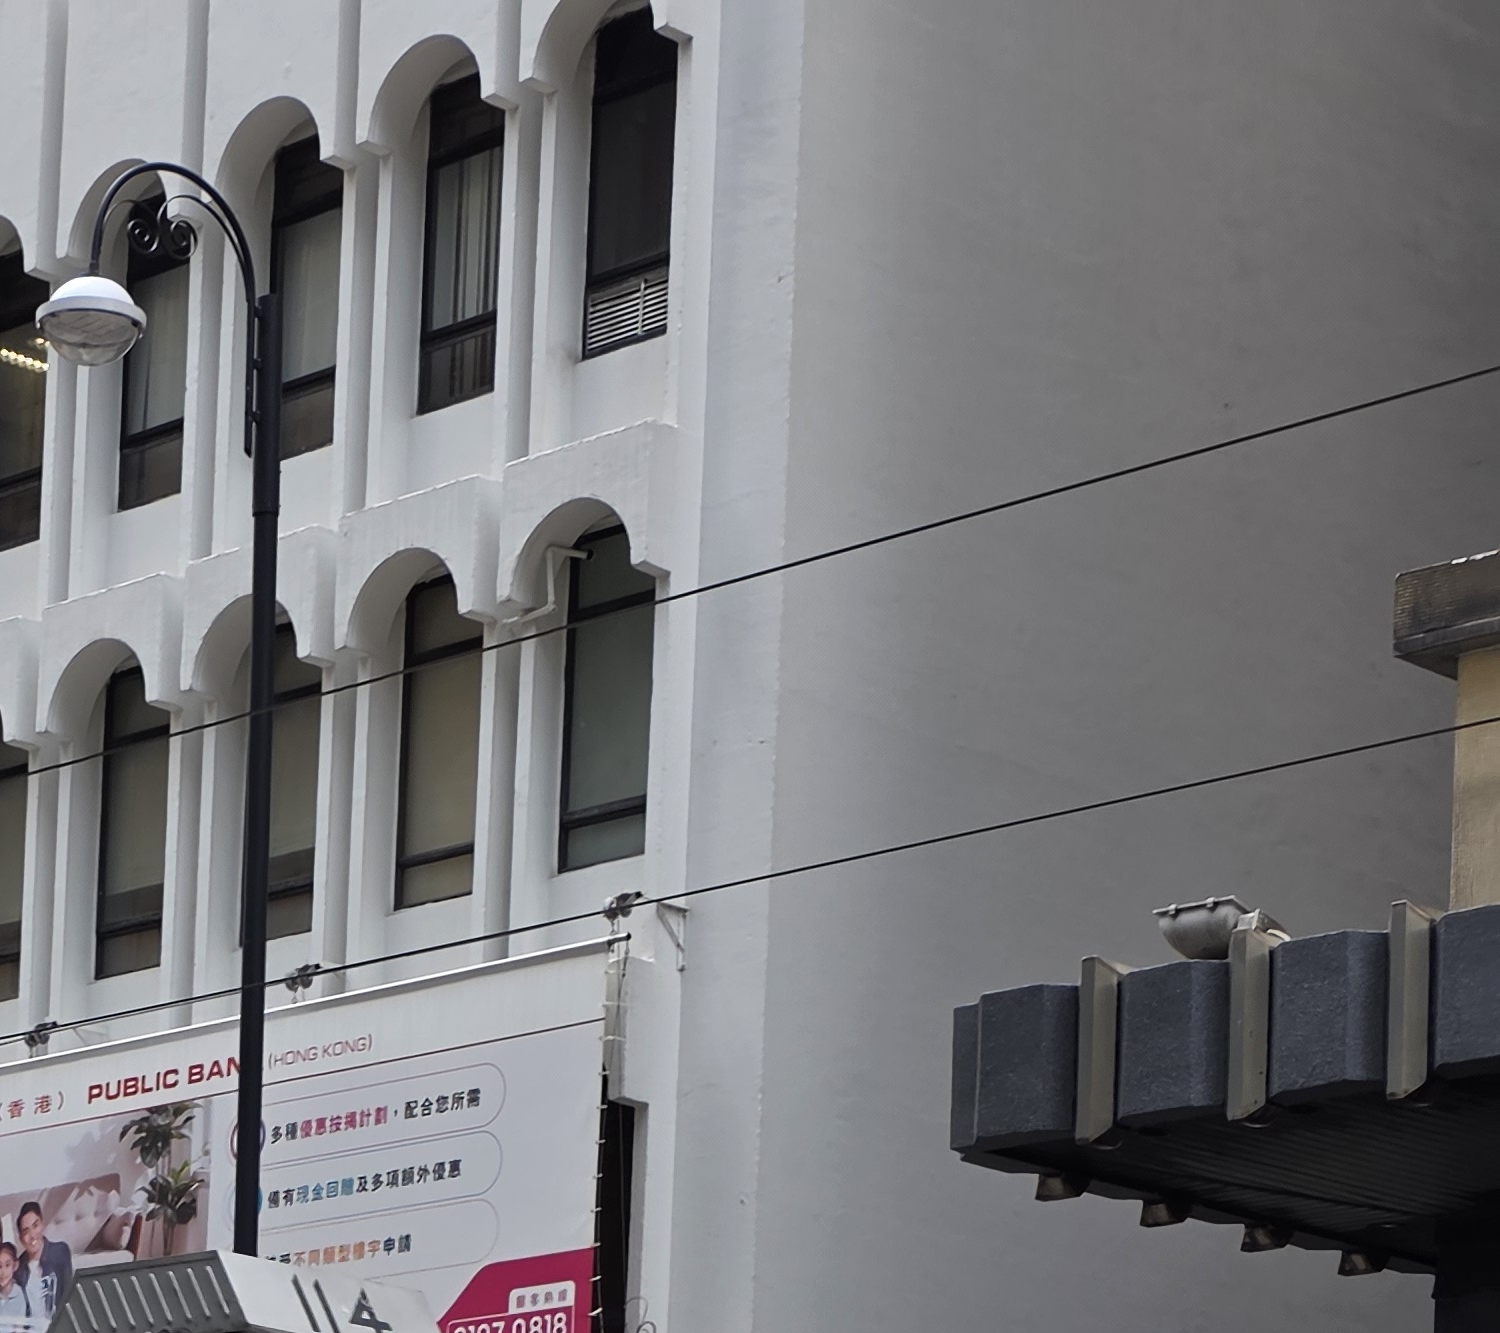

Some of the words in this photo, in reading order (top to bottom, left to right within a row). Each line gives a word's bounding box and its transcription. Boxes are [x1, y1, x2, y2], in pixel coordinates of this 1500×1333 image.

[88, 1069, 180, 1104] PUBLIC
[188, 1056, 242, 1085] BAN
[268, 1044, 319, 1071] (HONG
[322, 1033, 373, 1058] KONG)
